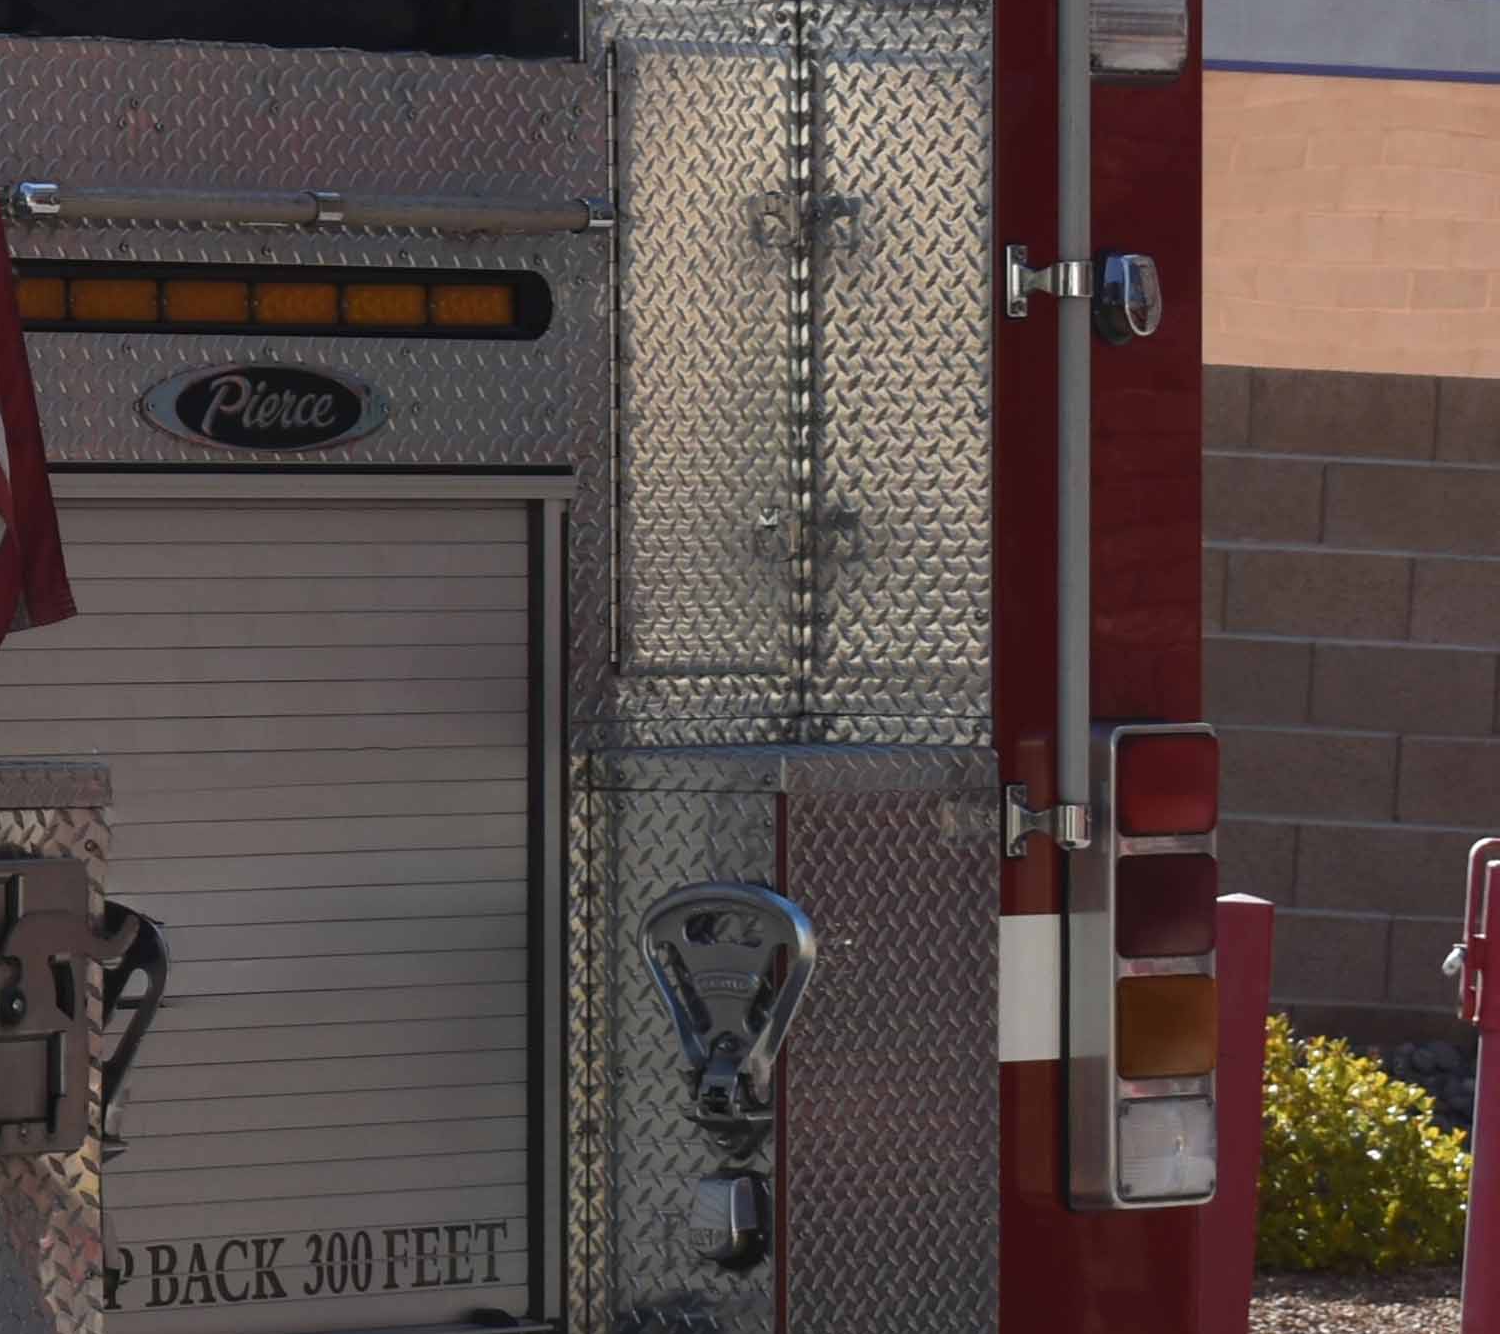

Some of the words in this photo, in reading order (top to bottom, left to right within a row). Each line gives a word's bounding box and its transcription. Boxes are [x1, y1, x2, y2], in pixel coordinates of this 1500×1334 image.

[202, 374, 336, 437] Pierce
[145, 1237, 287, 1308] BACK
[303, 1230, 373, 1296] 300
[382, 1221, 508, 1289] FEET
